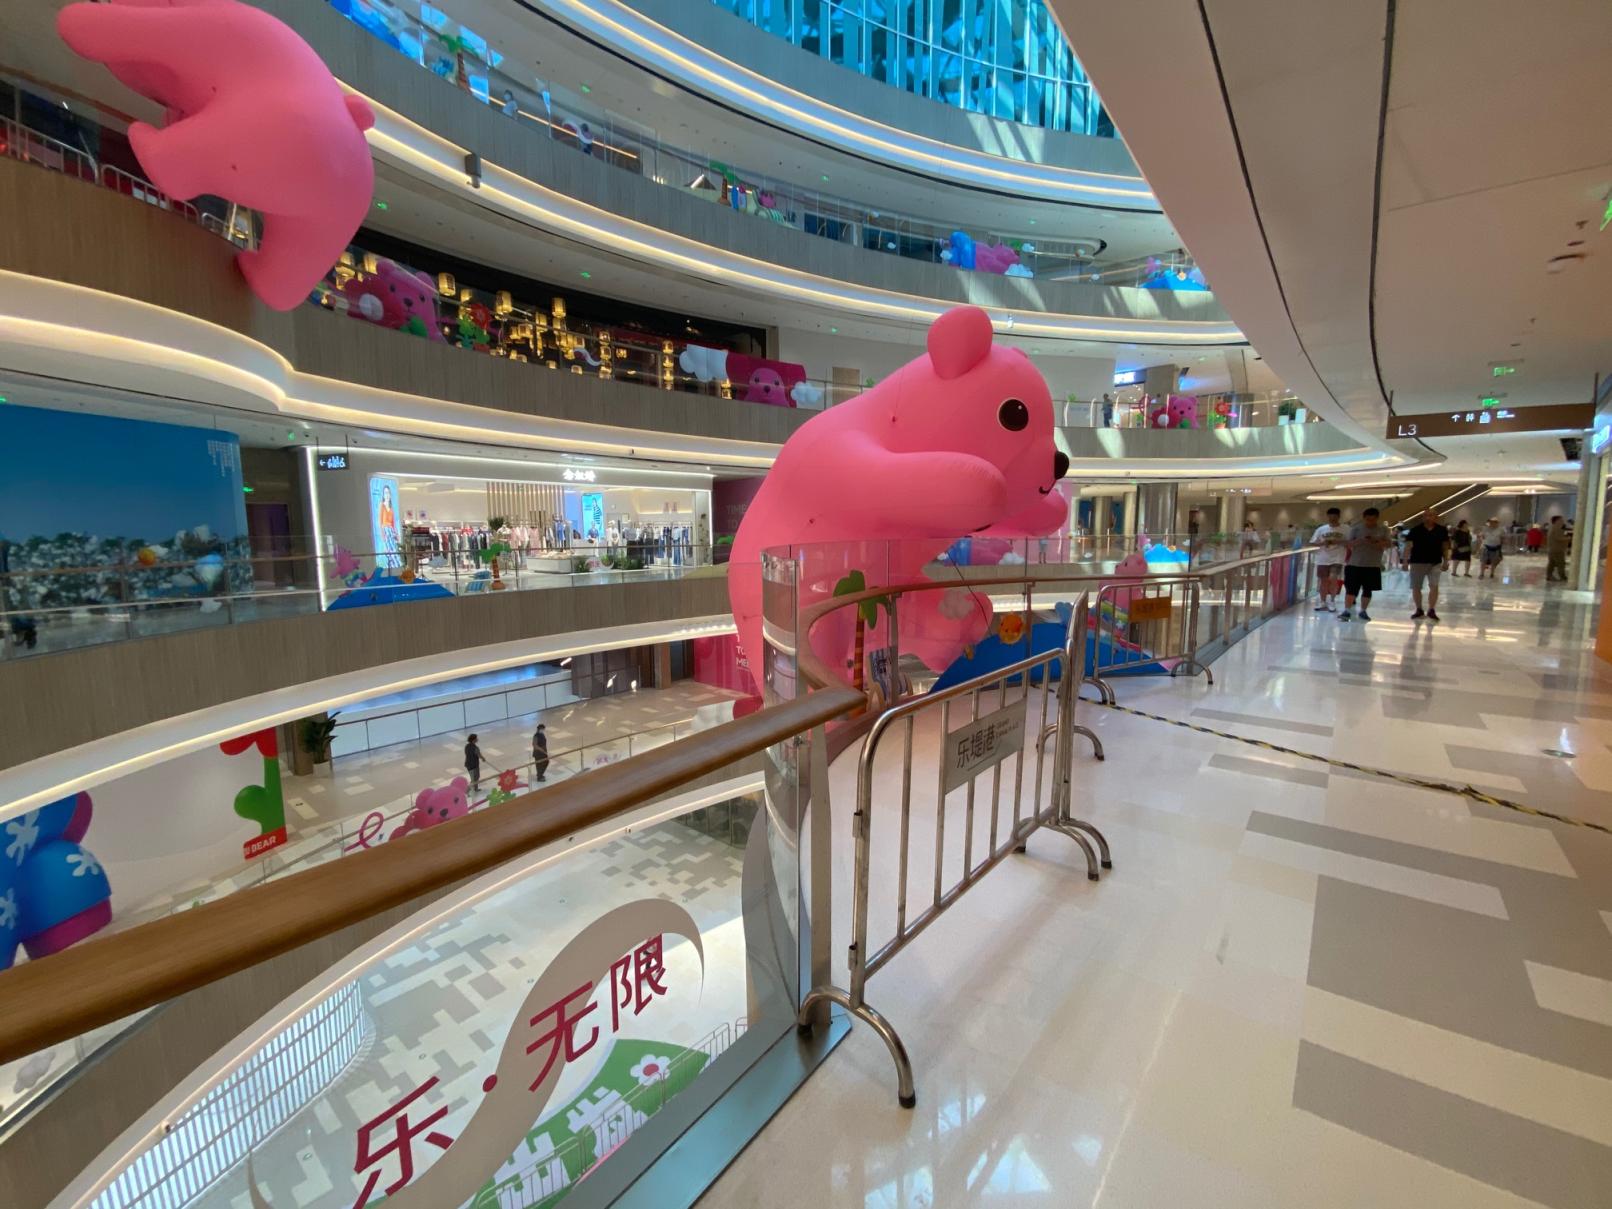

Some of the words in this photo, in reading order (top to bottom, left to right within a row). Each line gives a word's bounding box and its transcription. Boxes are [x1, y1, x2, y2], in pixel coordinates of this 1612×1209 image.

[1398, 424, 1417, 436] L3
[957, 724, 995, 768] 乐堤港
